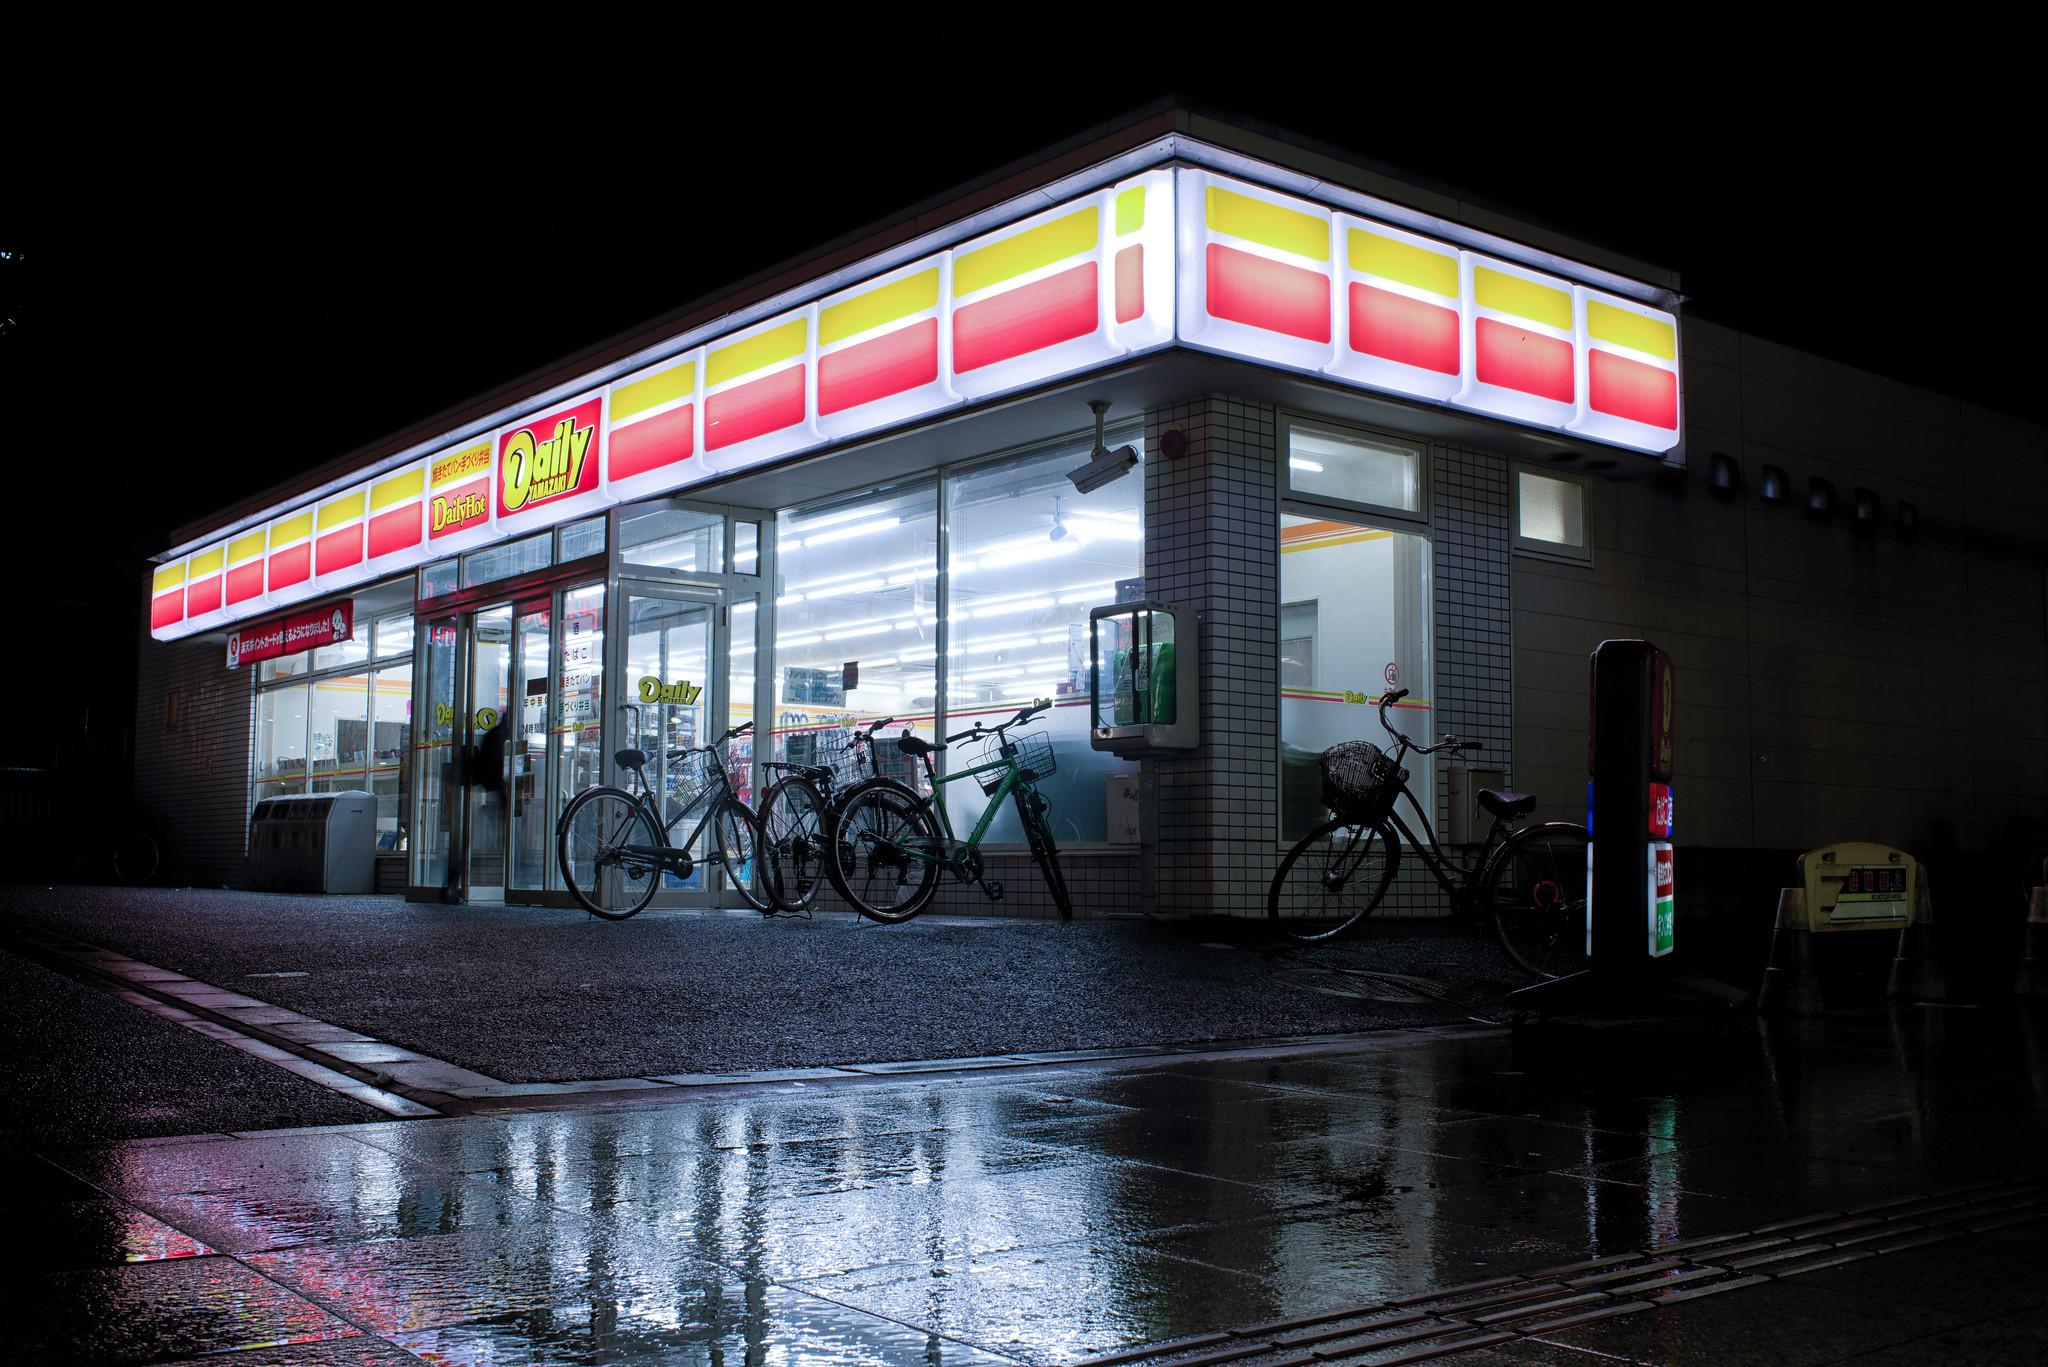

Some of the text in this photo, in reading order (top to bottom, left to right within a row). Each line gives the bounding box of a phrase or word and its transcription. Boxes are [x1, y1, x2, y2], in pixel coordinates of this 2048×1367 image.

[503, 418, 594, 510] Daily
[529, 474, 567, 502] YAMAZAKI
[564, 647, 588, 662] たばこ
[638, 676, 703, 705] Daily
